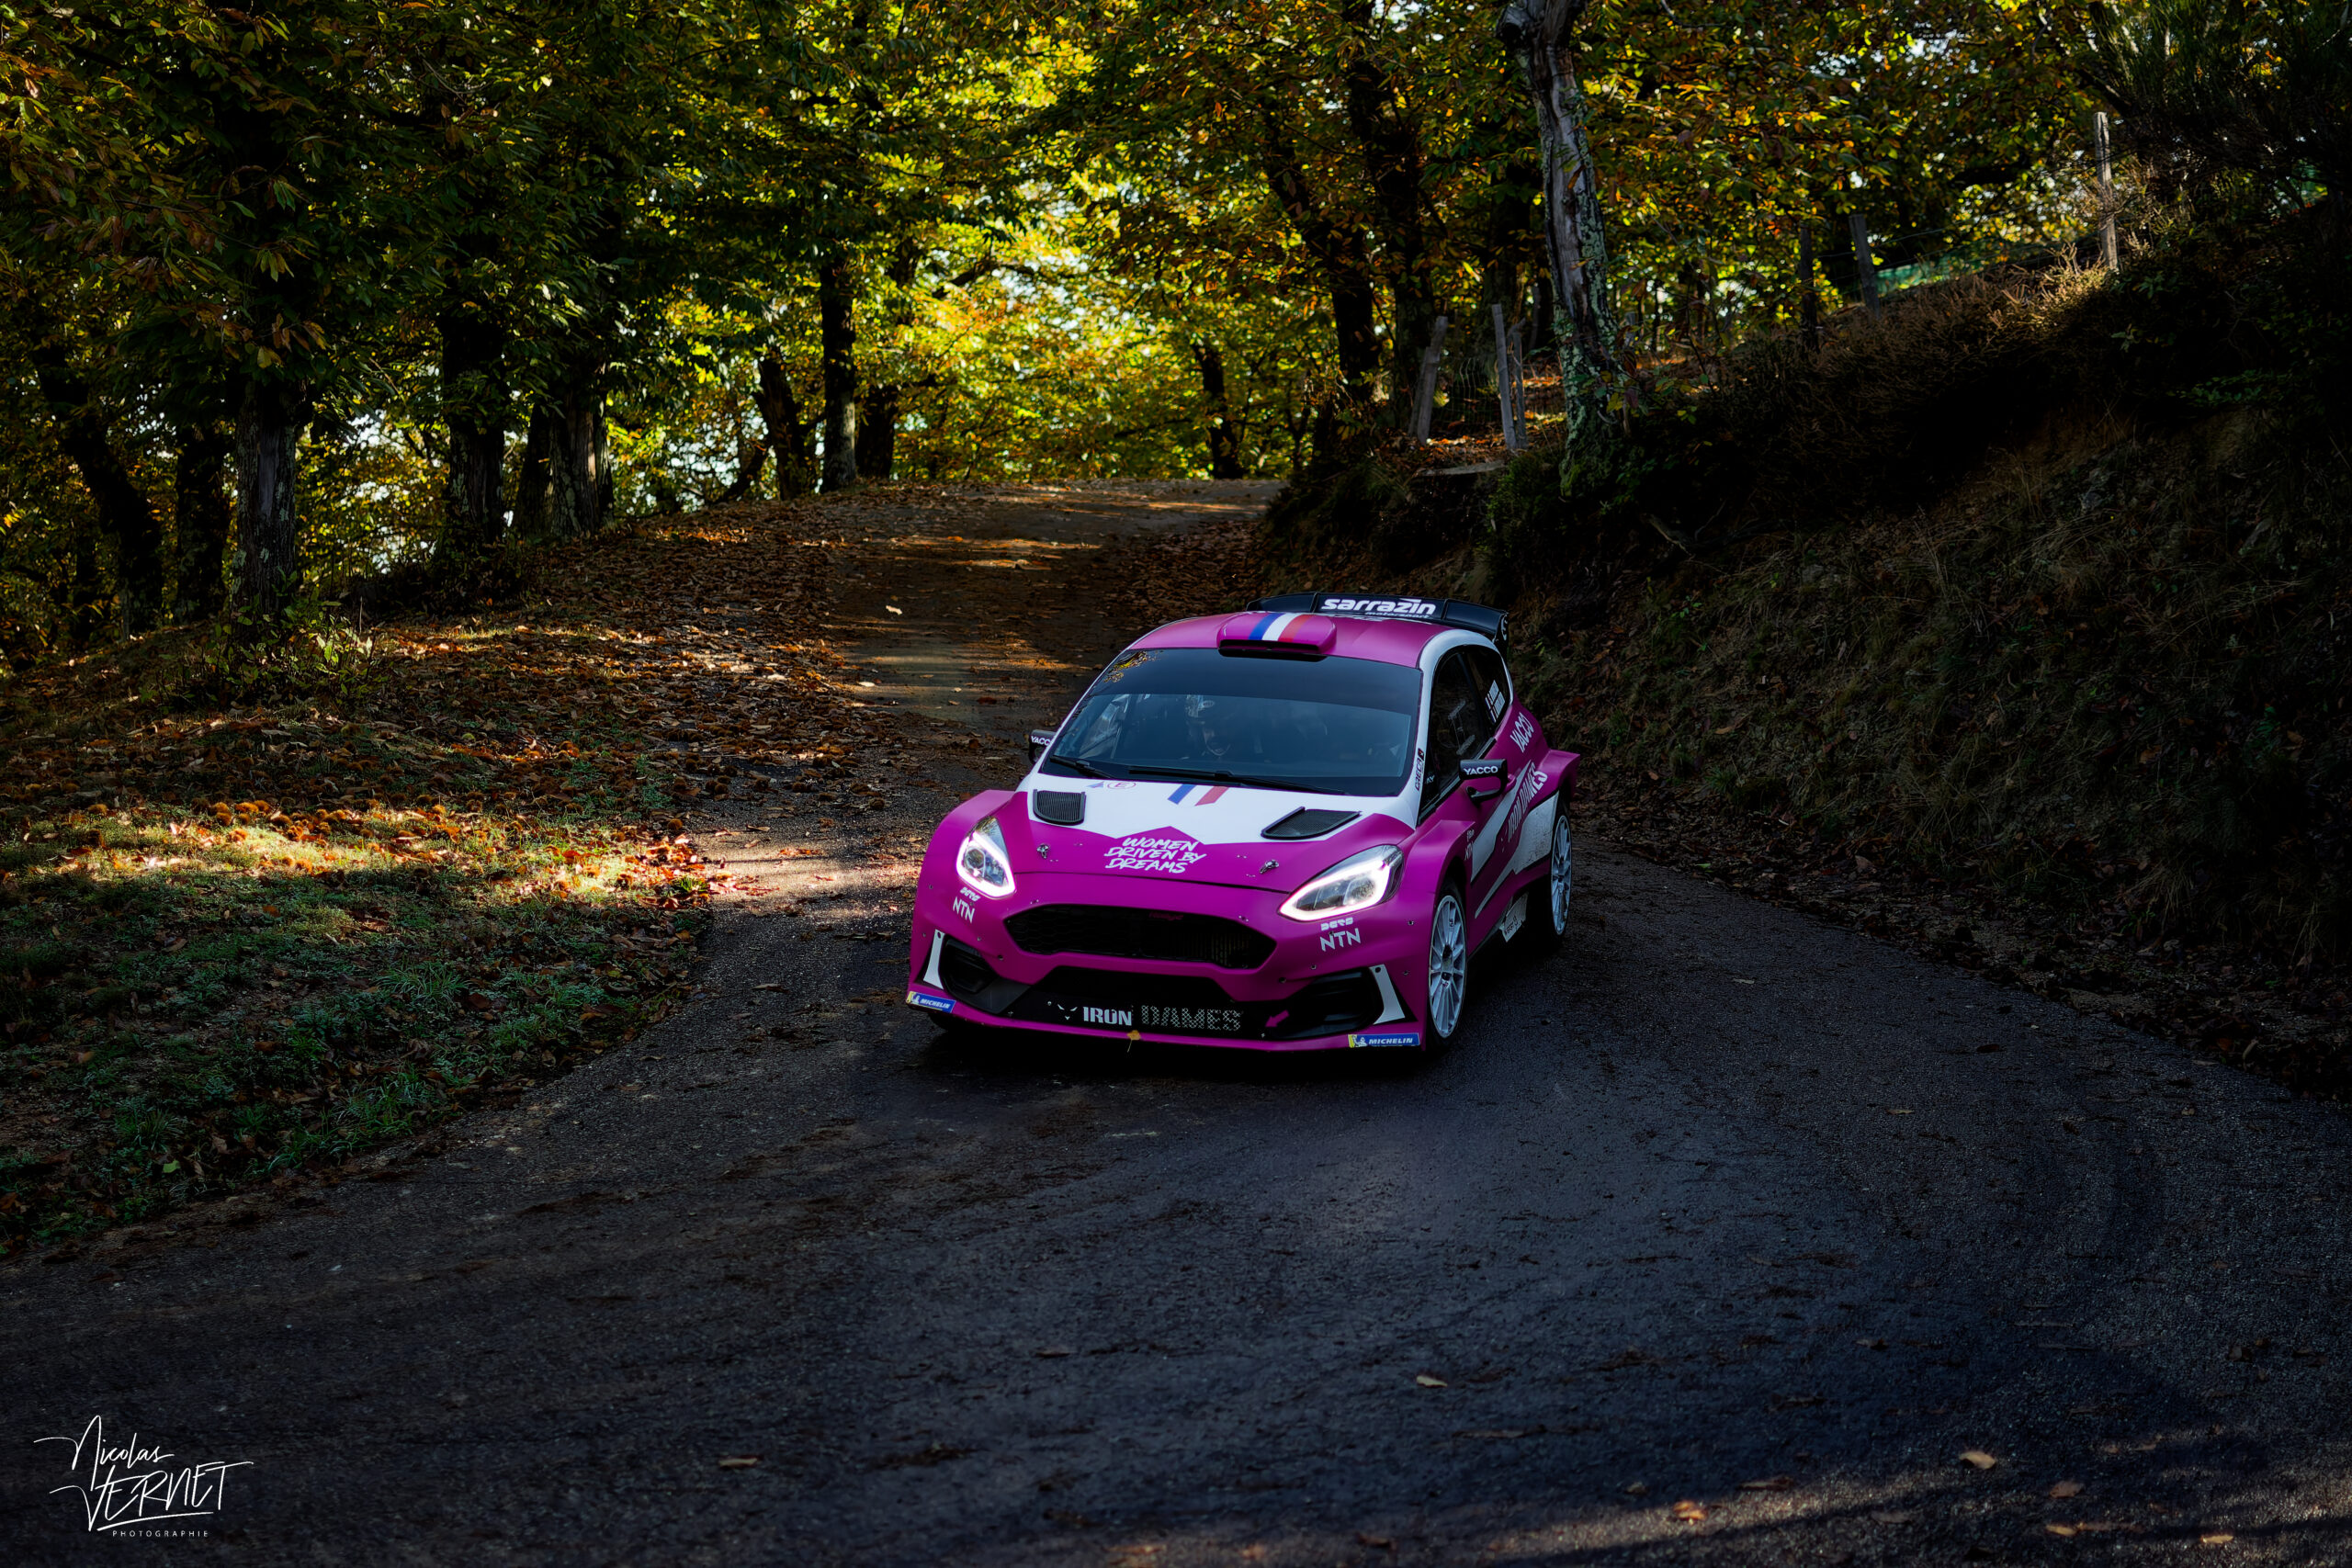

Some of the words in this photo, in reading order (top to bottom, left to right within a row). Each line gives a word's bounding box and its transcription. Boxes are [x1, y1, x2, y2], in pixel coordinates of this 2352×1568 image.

[1321, 598, 1436, 615] sarrazin
[1030, 735, 1051, 746] YACC
[1510, 711, 1534, 753] YACCO
[1463, 765, 1498, 775] YACCO
[1122, 837, 1200, 852] WOMEN
[1104, 846, 1178, 860] DRIVEN
[1178, 852, 1207, 863] BY
[1104, 857, 1189, 874] DREAMS
[953, 897, 975, 923] NTN
[1319, 927, 1362, 952] NTN
[920, 998, 951, 1009] MICHELIN
[1082, 1006, 1133, 1026] IRON
[1141, 1005, 1241, 1031] DAMES
